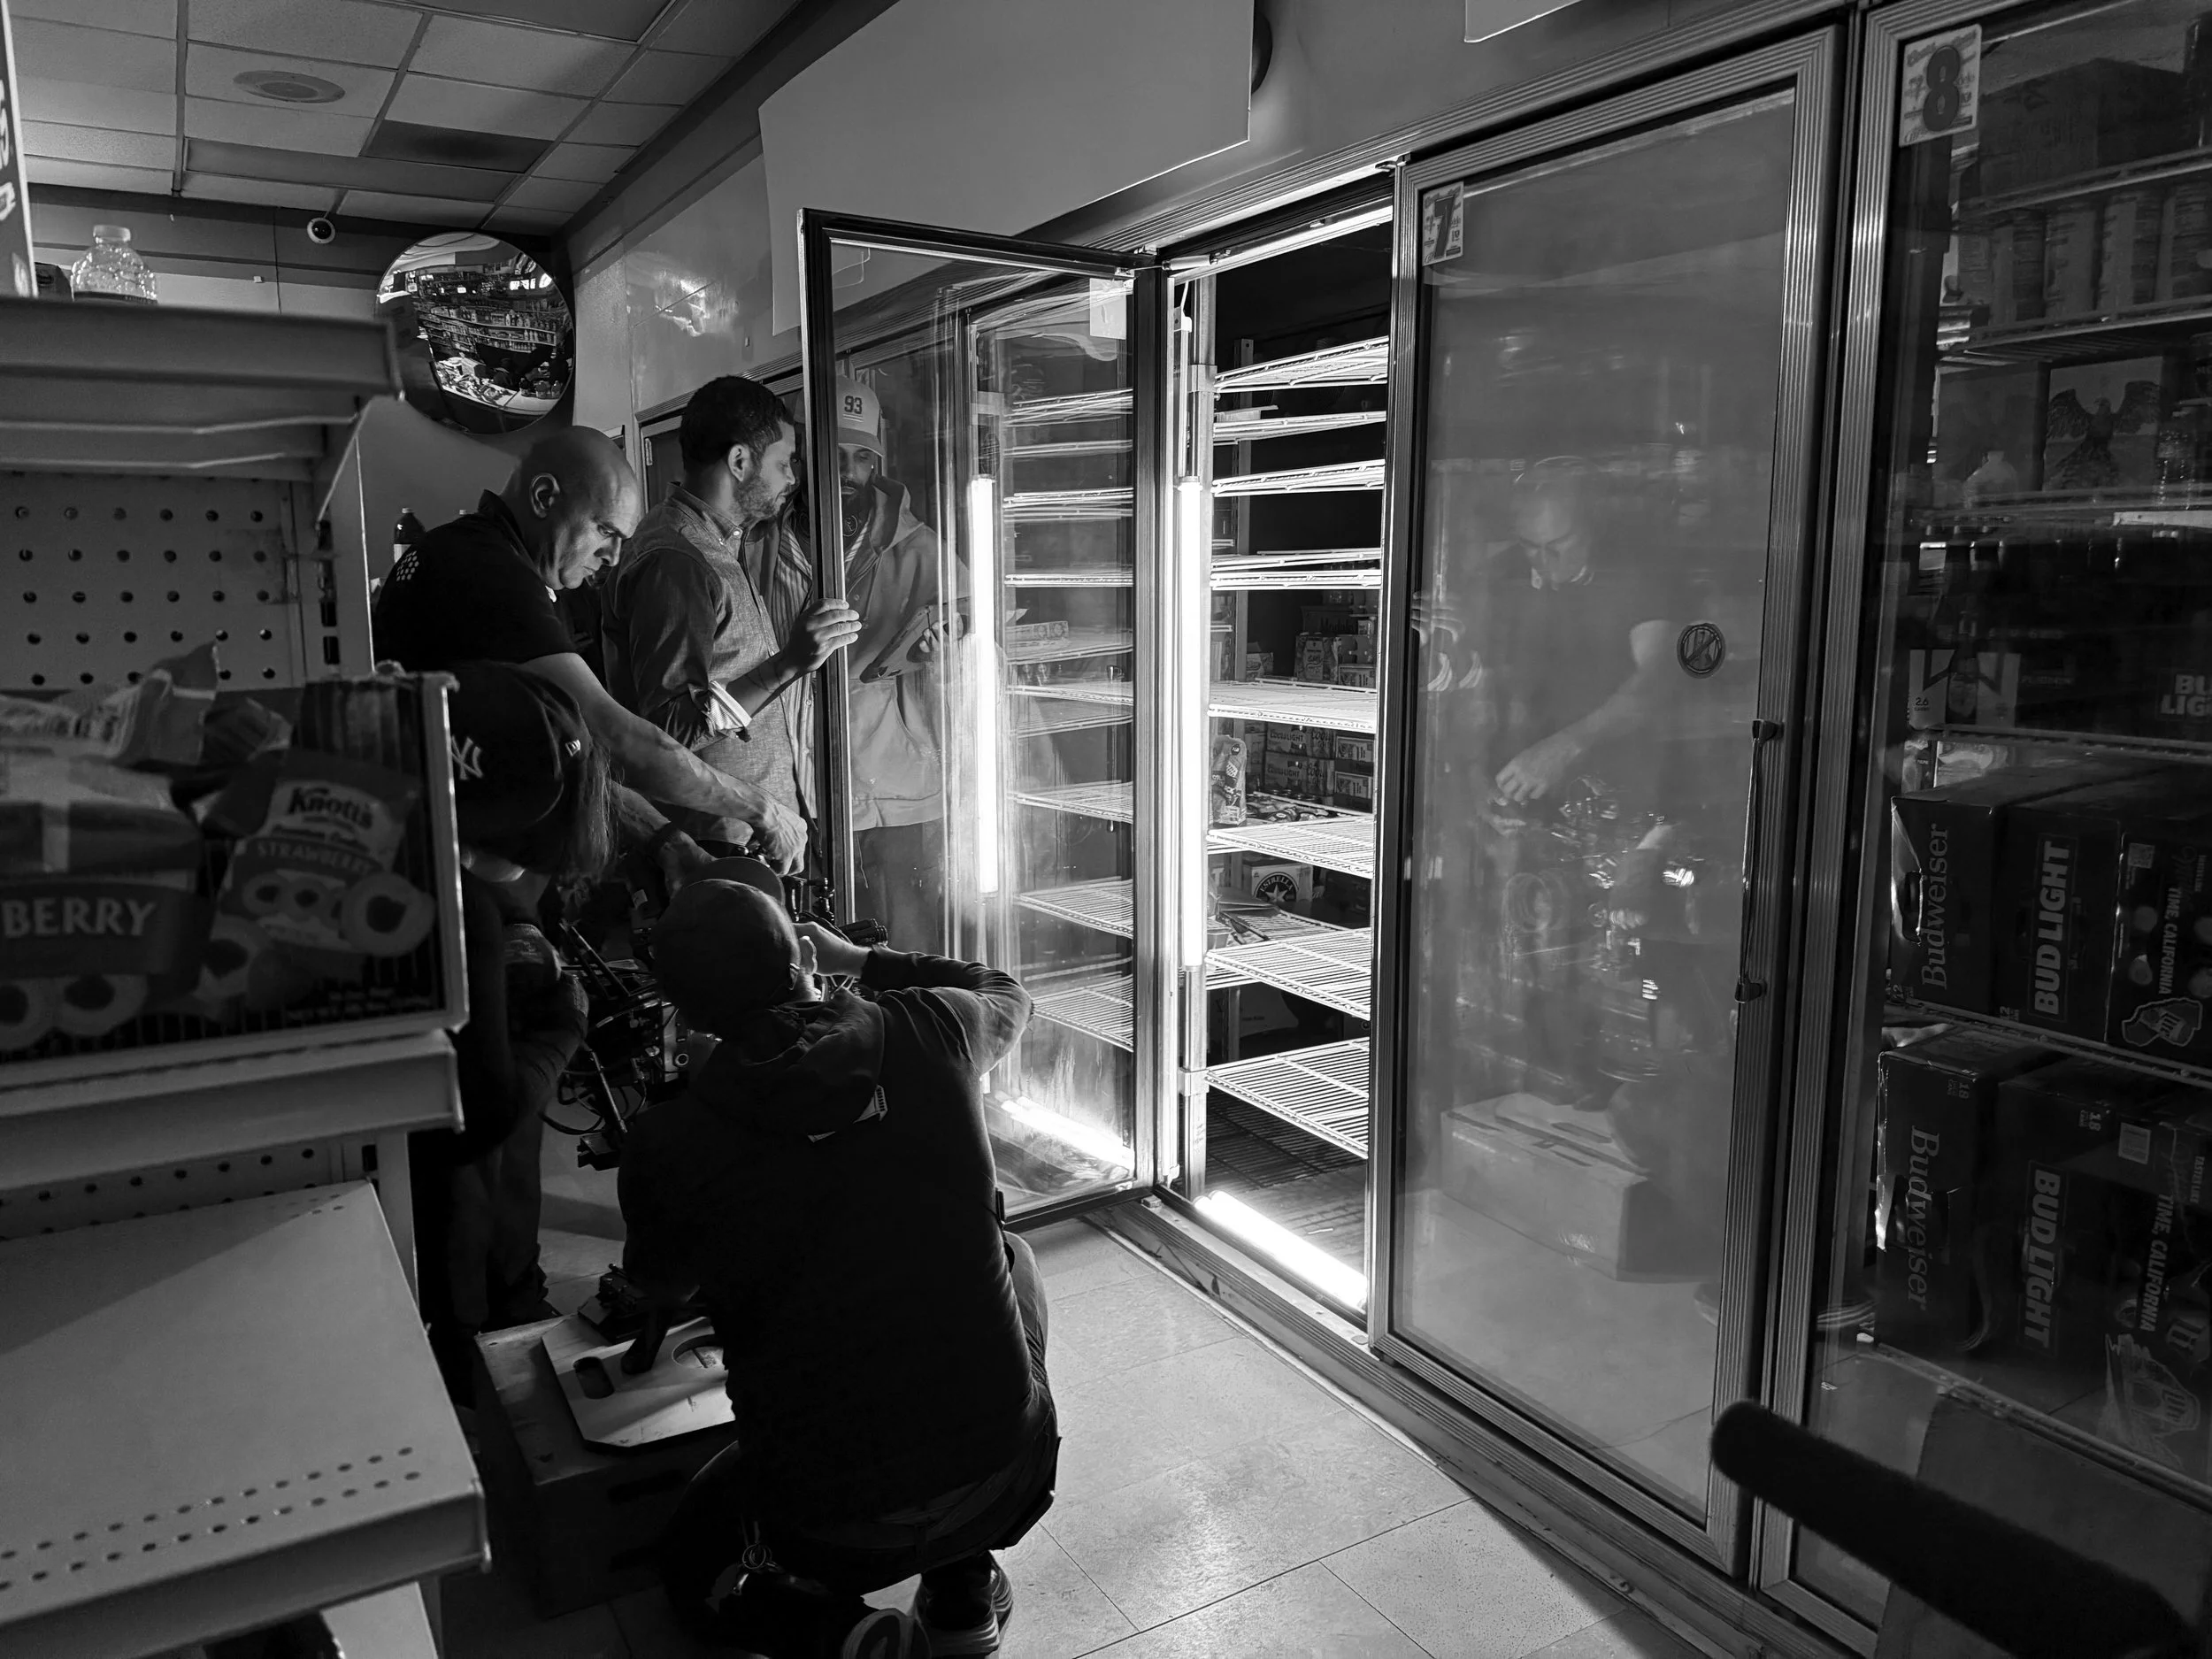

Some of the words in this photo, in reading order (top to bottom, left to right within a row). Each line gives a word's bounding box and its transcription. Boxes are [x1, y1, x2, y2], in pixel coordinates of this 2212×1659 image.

[1923, 45, 1961, 132] 8
[1434, 195, 1455, 258] 7
[844, 396, 863, 414] 93
[257, 840, 373, 878] STRAWBERRY
[1259, 875, 1294, 893] ESTRELLA
[2038, 841, 2070, 942] LIGHT
[1922, 822, 1949, 990] Budweiser
[2033, 943, 2062, 1016] BUD
[2157, 923, 2178, 995] CALIFORNIA
[1958, 1082, 1970, 1099] 18
[2088, 1111, 2102, 1132] 18
[1906, 1125, 1940, 1312] Budweiser
[2032, 1169, 2061, 1245] BUD
[2151, 1193, 2174, 1235] TIME,
[2024, 1245, 2057, 1348] LIGHT
[2139, 1240, 2169, 1333] CALIFORNIA
